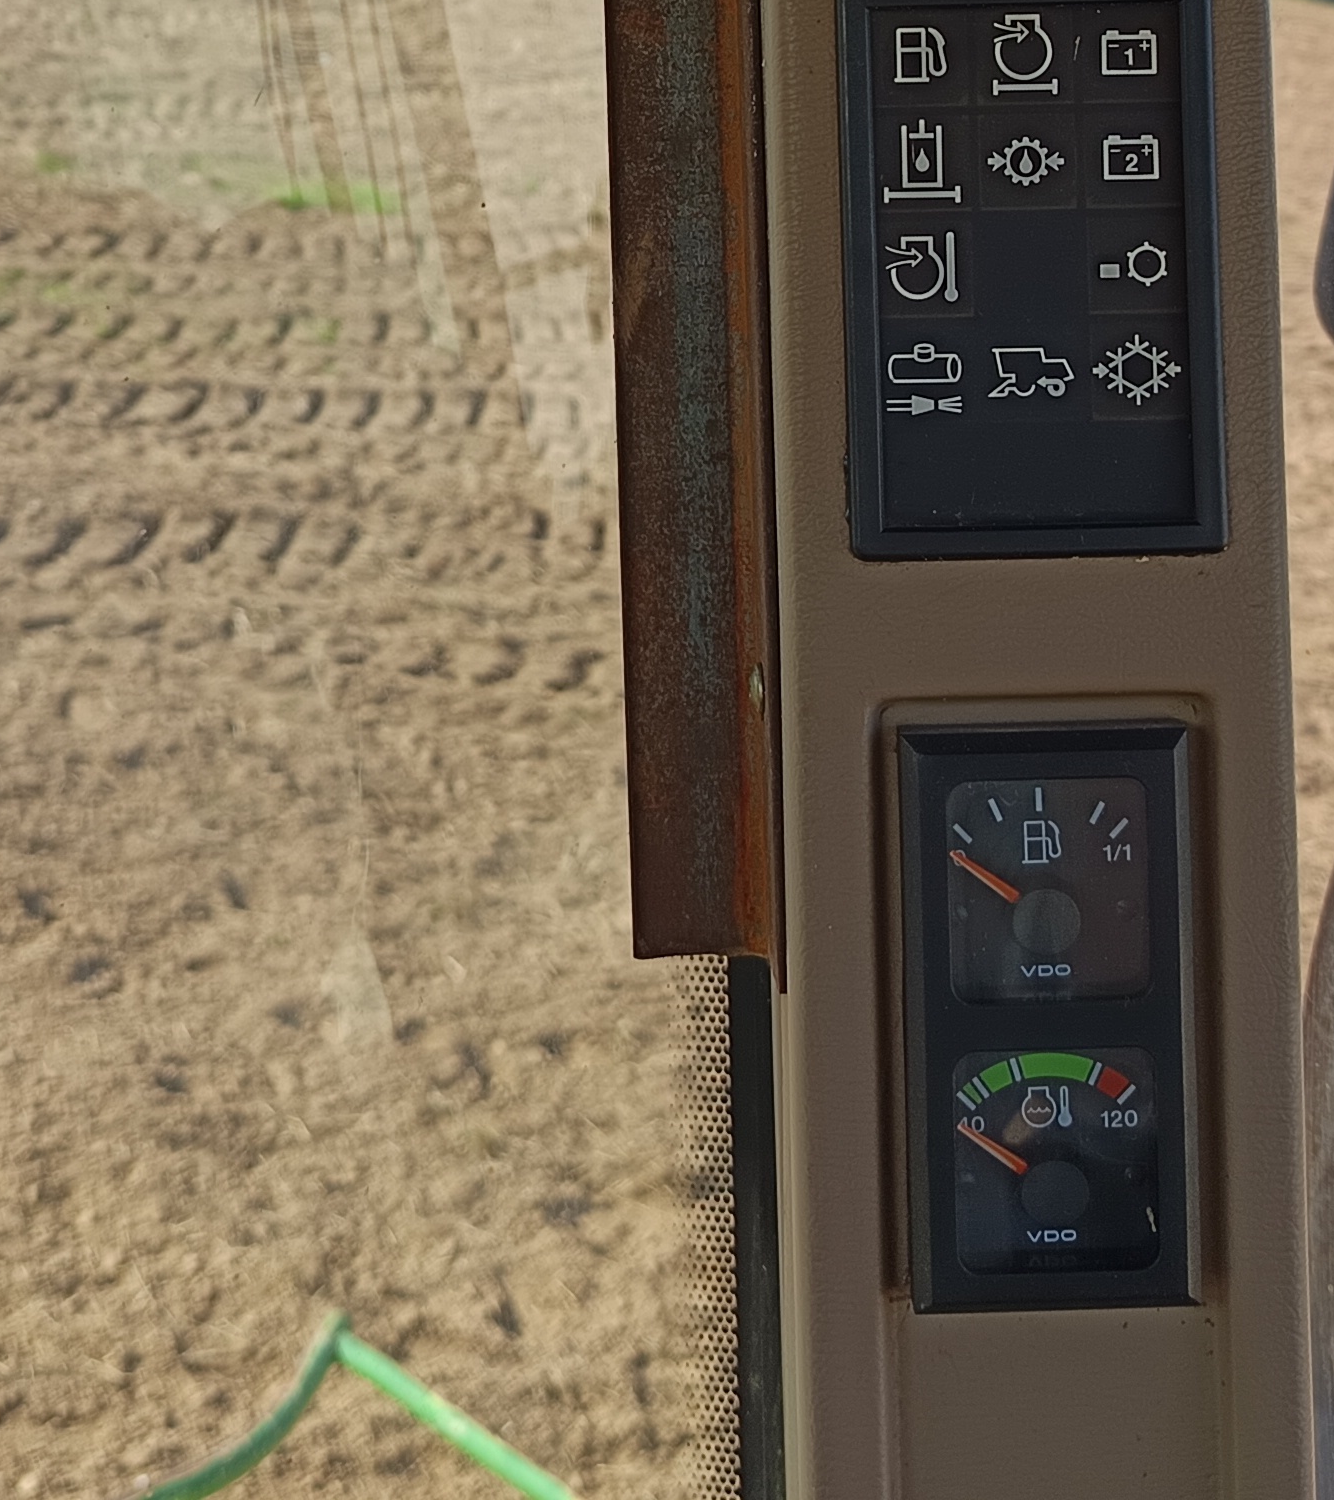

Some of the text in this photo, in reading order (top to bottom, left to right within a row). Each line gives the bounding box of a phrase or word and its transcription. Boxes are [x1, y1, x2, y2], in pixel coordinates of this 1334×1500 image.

[1123, 47, 1134, 66] 1
[1125, 153, 1139, 172] 2
[1102, 843, 1132, 862] 1/1
[1020, 964, 1071, 977] VDO
[1100, 1109, 1138, 1128] 120
[1026, 1229, 1077, 1243] VDO
